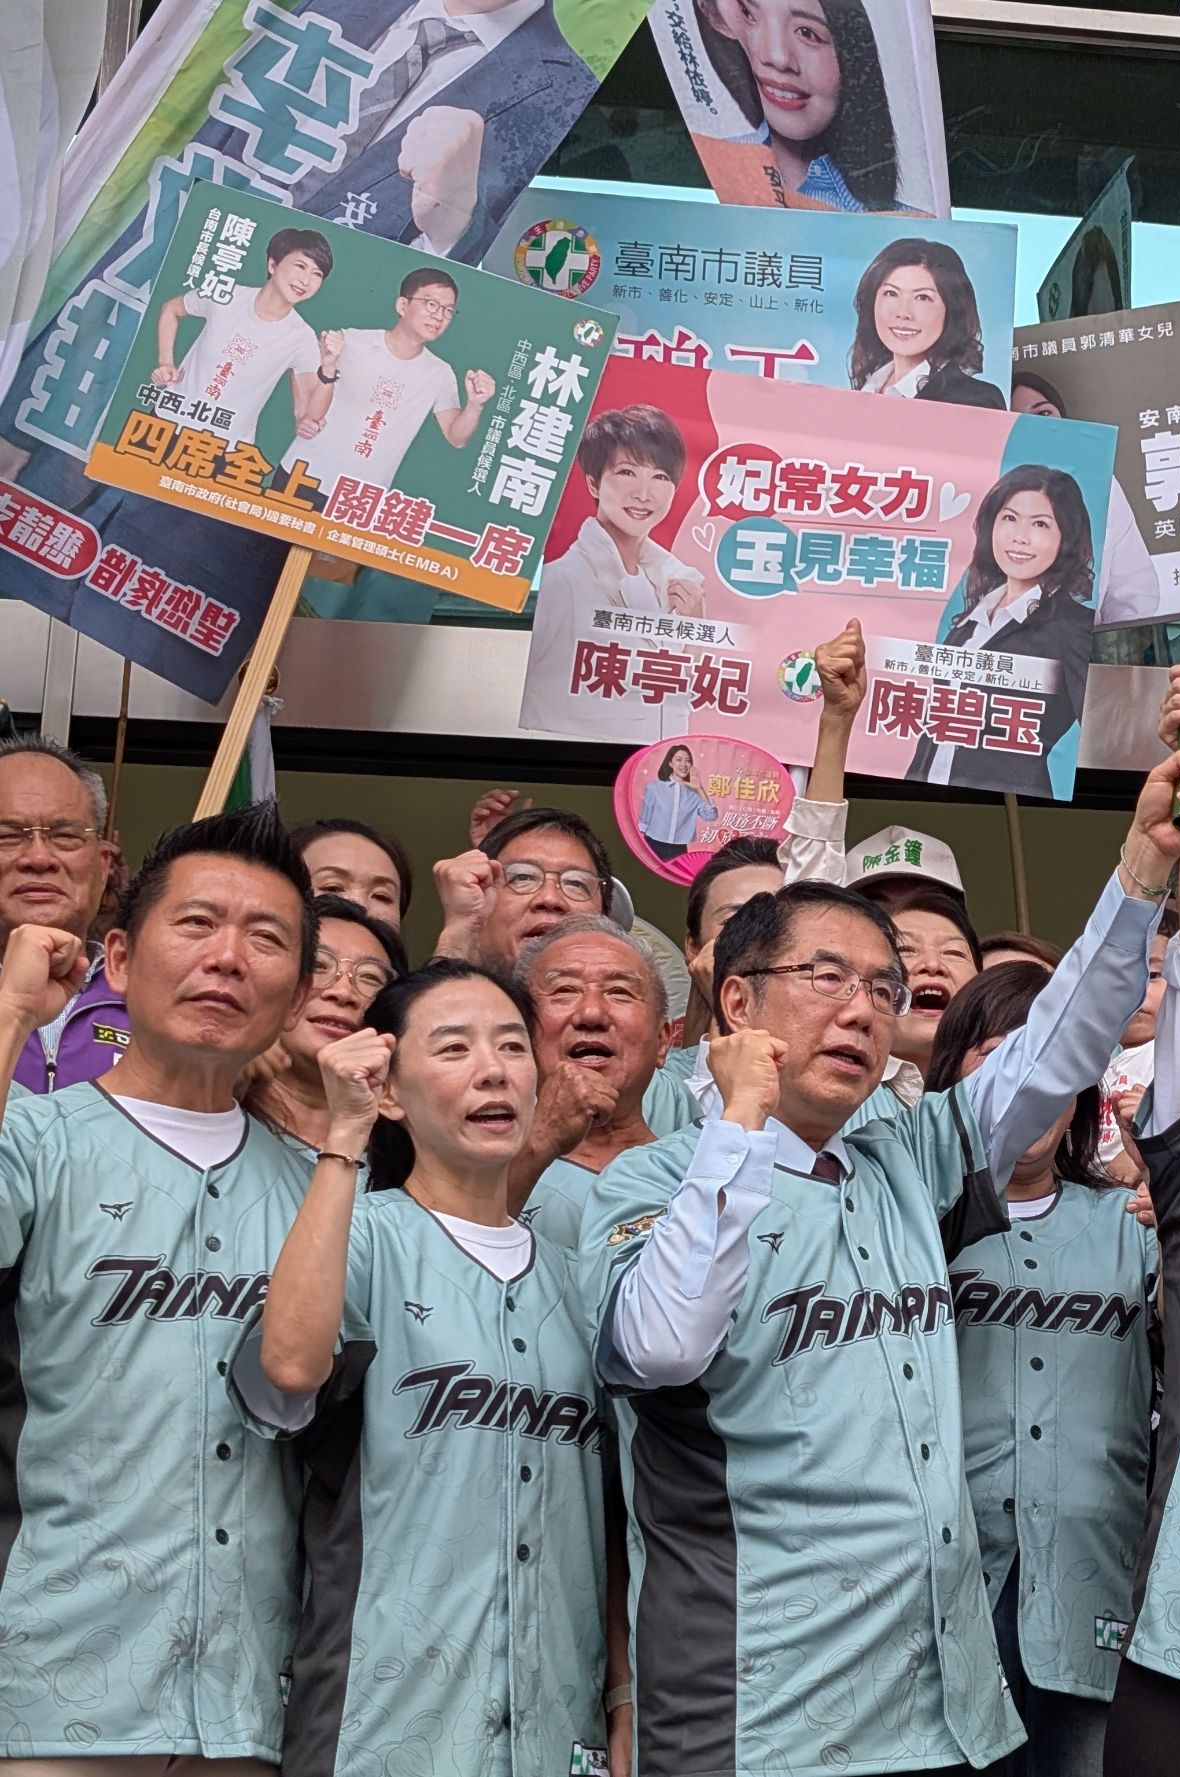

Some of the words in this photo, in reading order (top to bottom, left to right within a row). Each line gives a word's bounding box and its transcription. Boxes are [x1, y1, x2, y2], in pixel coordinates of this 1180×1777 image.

[199, 213, 257, 305] 陳亭妃
[614, 240, 825, 292] 臺南市議員
[113, 409, 323, 512] 四席全上
[489, 345, 590, 517] 林建南
[321, 475, 535, 577] 關鍵一席
[718, 456, 933, 522] 妃常女力
[730, 526, 951, 592] 玉見幸福
[592, 609, 735, 647] 臺南市長候選人
[914, 643, 1015, 675] 臺南市議員
[570, 640, 751, 717] 陳亭妃
[867, 677, 1046, 755] 陳碧玉
